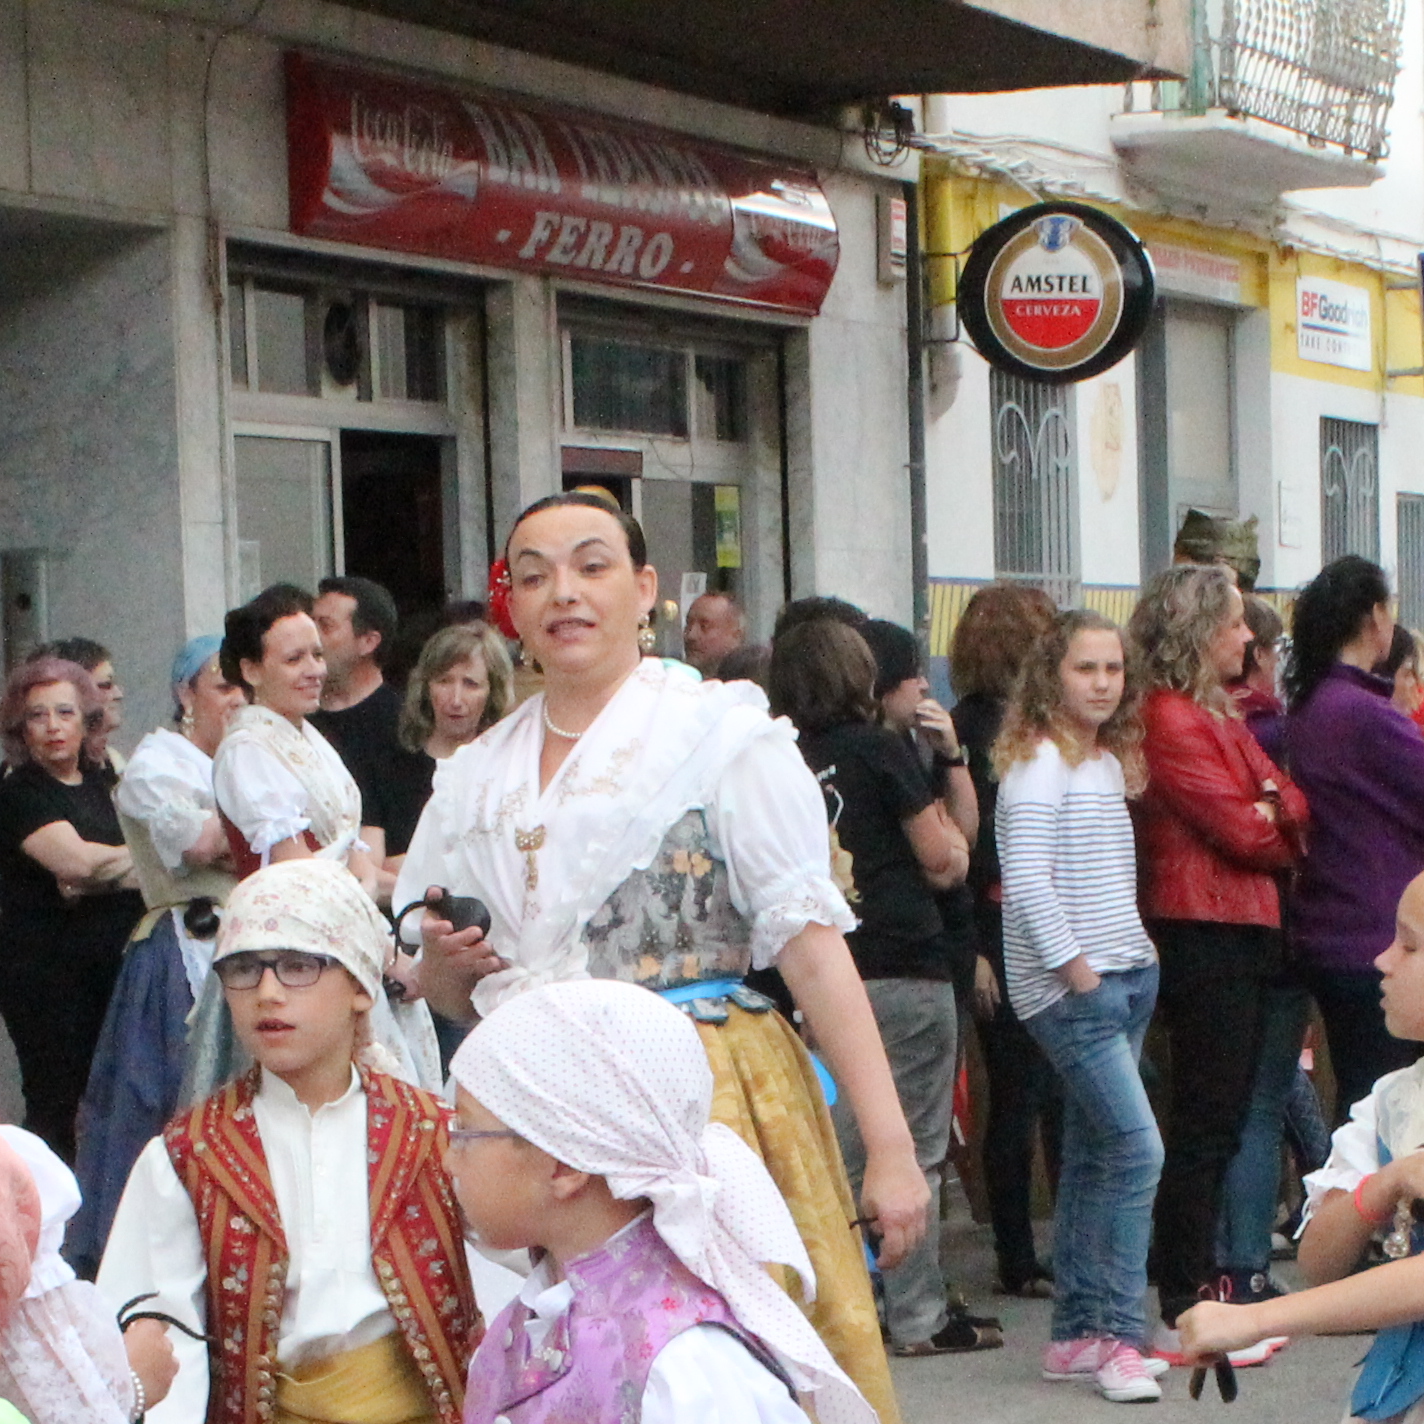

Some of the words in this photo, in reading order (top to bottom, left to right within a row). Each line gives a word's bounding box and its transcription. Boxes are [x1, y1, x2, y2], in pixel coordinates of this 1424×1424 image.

[464, 101, 561, 194] BAR
[518, 211, 674, 279] FERRO
[1011, 274, 1091, 293] AMSTEL
[1016, 304, 1081, 317] CERVEZA
